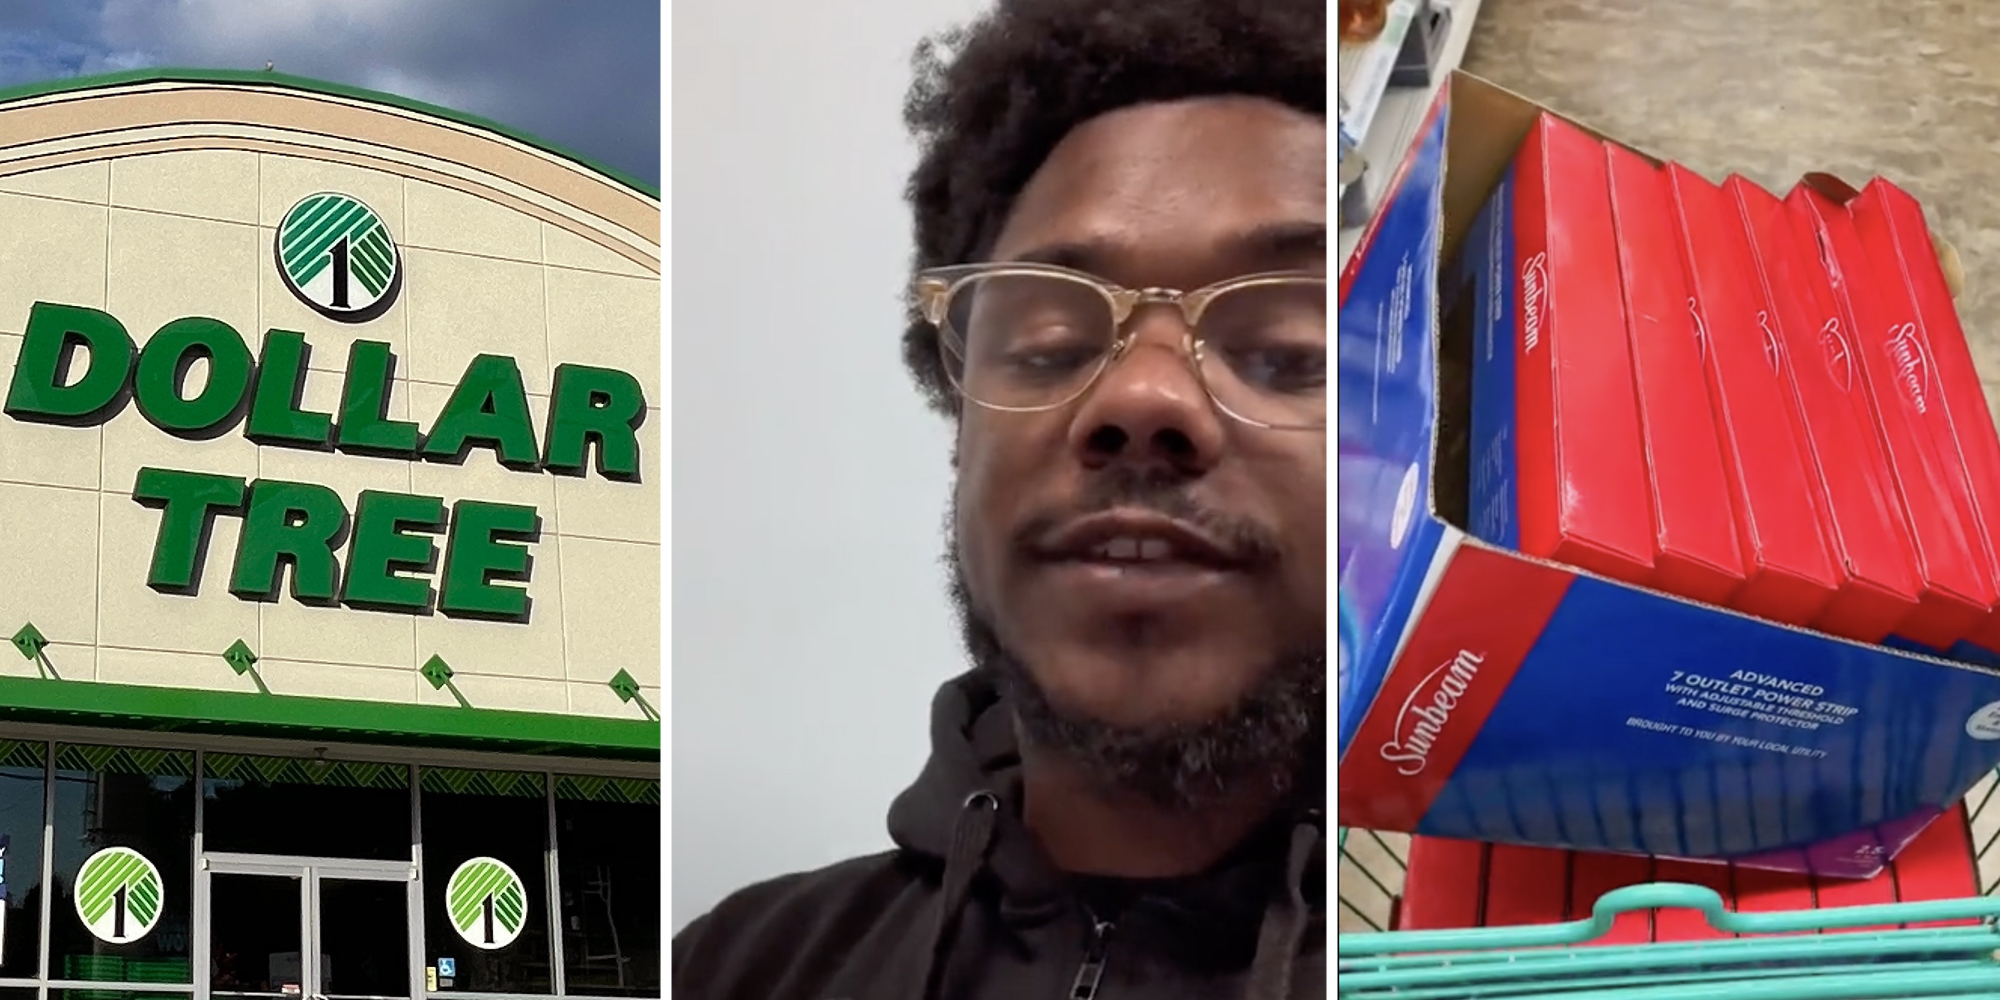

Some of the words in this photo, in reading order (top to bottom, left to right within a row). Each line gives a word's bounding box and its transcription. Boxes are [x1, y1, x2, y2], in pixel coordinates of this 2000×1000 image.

[1523, 252, 1546, 355] Sunbeam
[3, 302, 647, 482] DOLLAR
[132, 467, 543, 623] TREE
[1665, 683, 1698, 697] WITH
[1699, 690, 1776, 713] ADJUSTABLE
[1776, 707, 1844, 726] THRESHOLD
[1670, 671, 1684, 682] 7
[1685, 674, 1753, 697] OUTLET
[1753, 688, 1815, 710] POWER
[1814, 701, 1859, 718] STRIP
[1729, 669, 1824, 697] ADVANCED
[1380, 649, 1484, 775] Sunbeam
[1626, 716, 1679, 734] BROUGHT
[1679, 726, 1694, 737] TO
[1694, 729, 1715, 741] YOU
[1715, 733, 1731, 743] BY
[1731, 736, 1760, 749] YOUR
[1676, 697, 1707, 710] AND
[1707, 702, 1749, 719] SURGE
[1749, 711, 1820, 730] PROTECTOR
